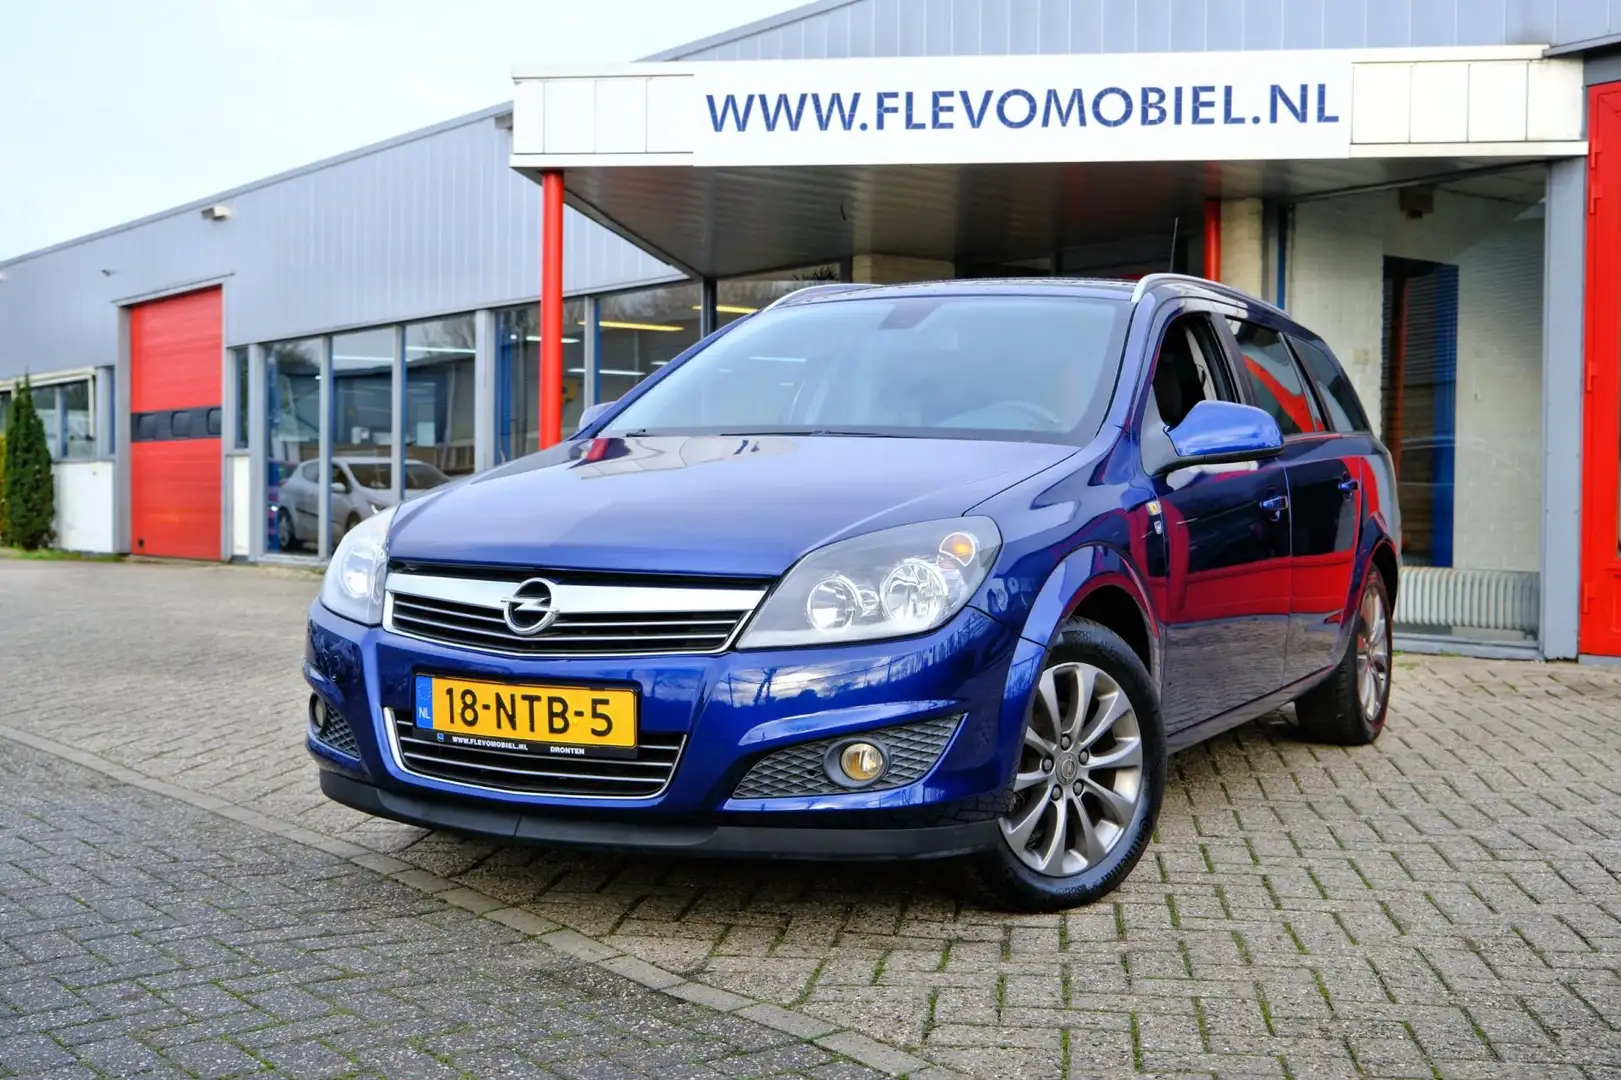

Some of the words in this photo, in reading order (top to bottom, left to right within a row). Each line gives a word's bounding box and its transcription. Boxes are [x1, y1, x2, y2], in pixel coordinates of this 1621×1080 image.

[706, 83, 1340, 132] WWW.FLEVOMOBIEL.NL
[418, 707, 431, 719] NL
[445, 687, 613, 737] 18-NTB-5
[452, 736, 528, 751] WWW.FLEVOMOBIEL.NL
[550, 746, 585, 755] DRONTEN
